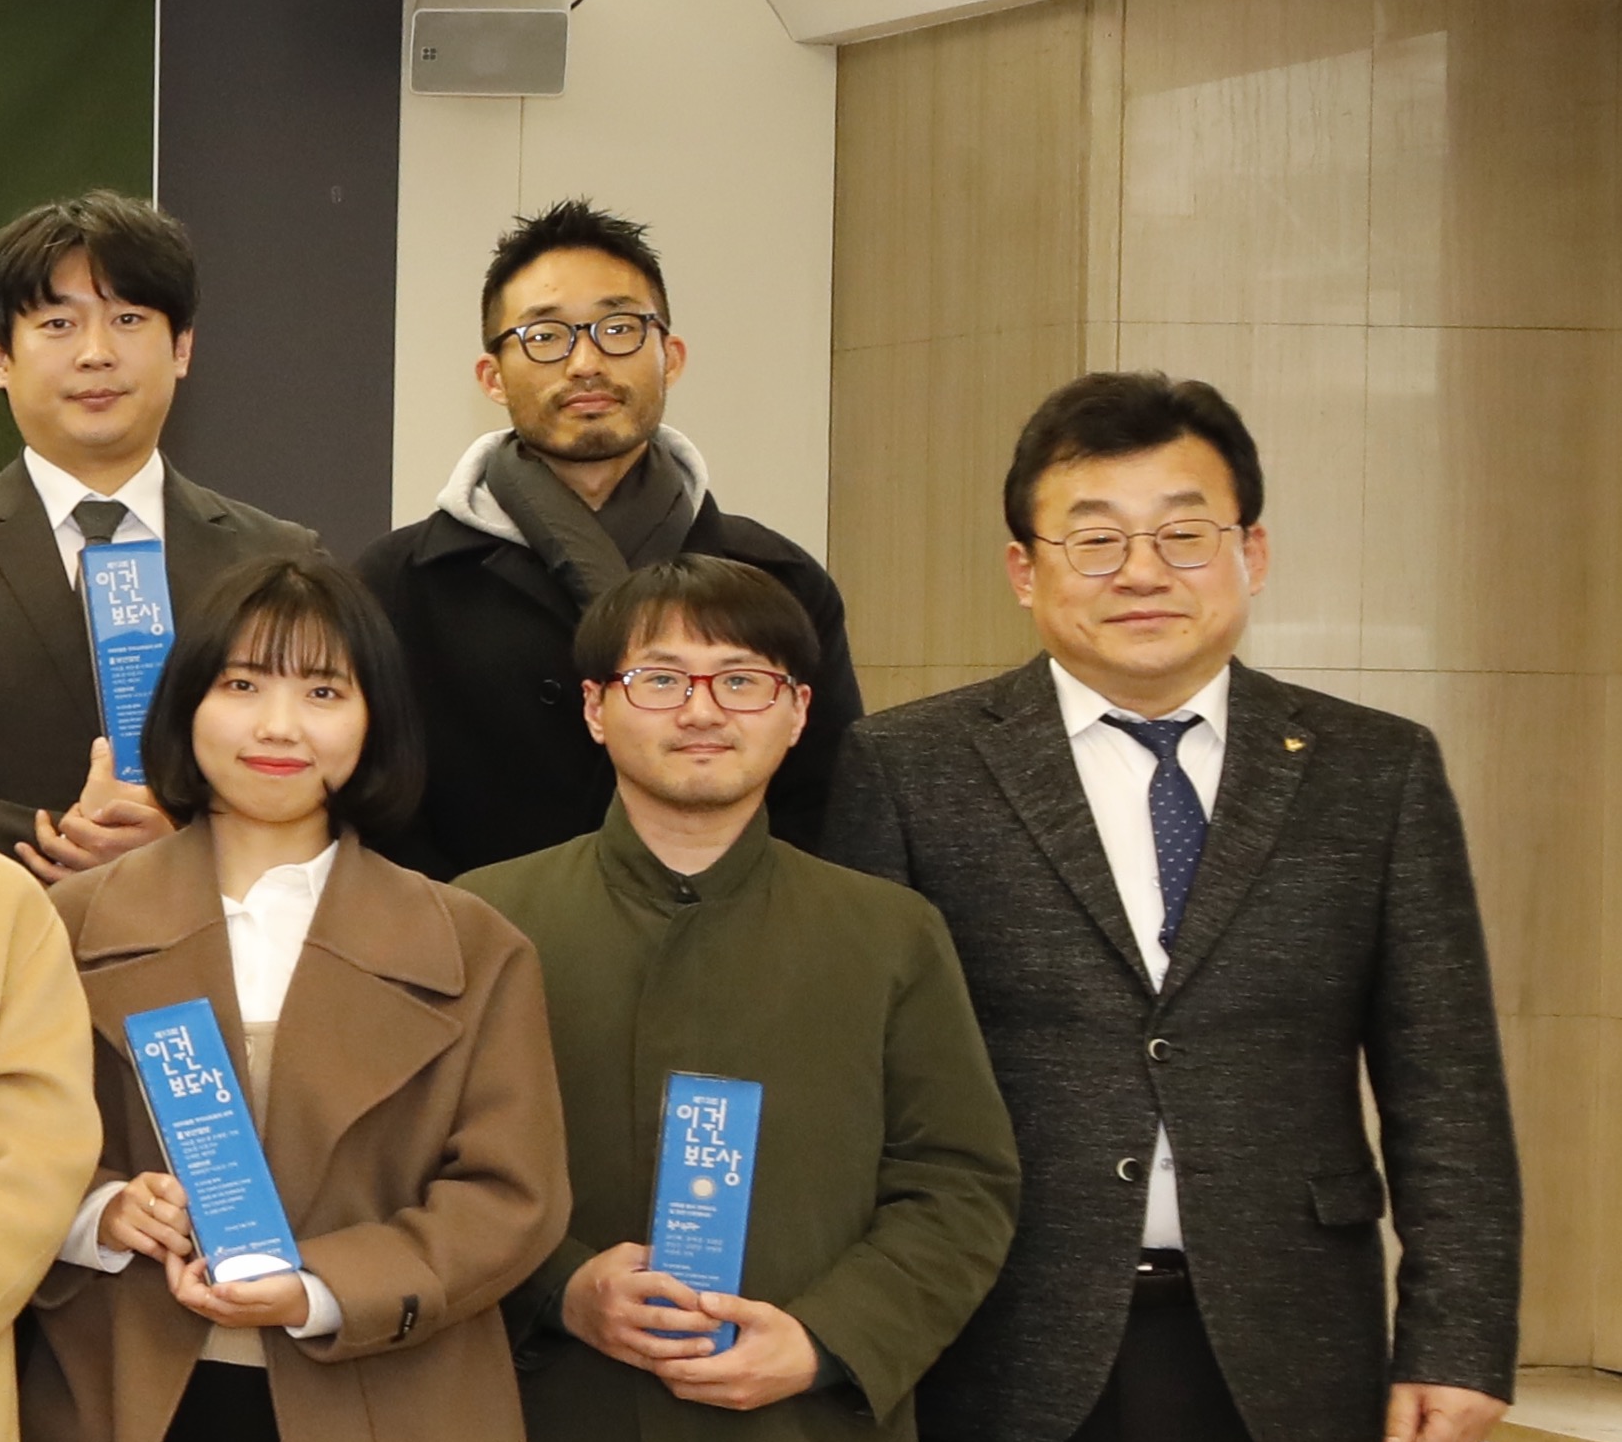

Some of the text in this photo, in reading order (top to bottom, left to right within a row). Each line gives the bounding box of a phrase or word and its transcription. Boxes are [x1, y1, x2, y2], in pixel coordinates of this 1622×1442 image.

[95, 559, 143, 605] 인권
[111, 603, 165, 636] 보도상
[144, 1025, 202, 1076] 인권
[169, 1069, 232, 1103] 보도상
[676, 1098, 727, 1145] 인권
[684, 1145, 742, 1186] 보도상
